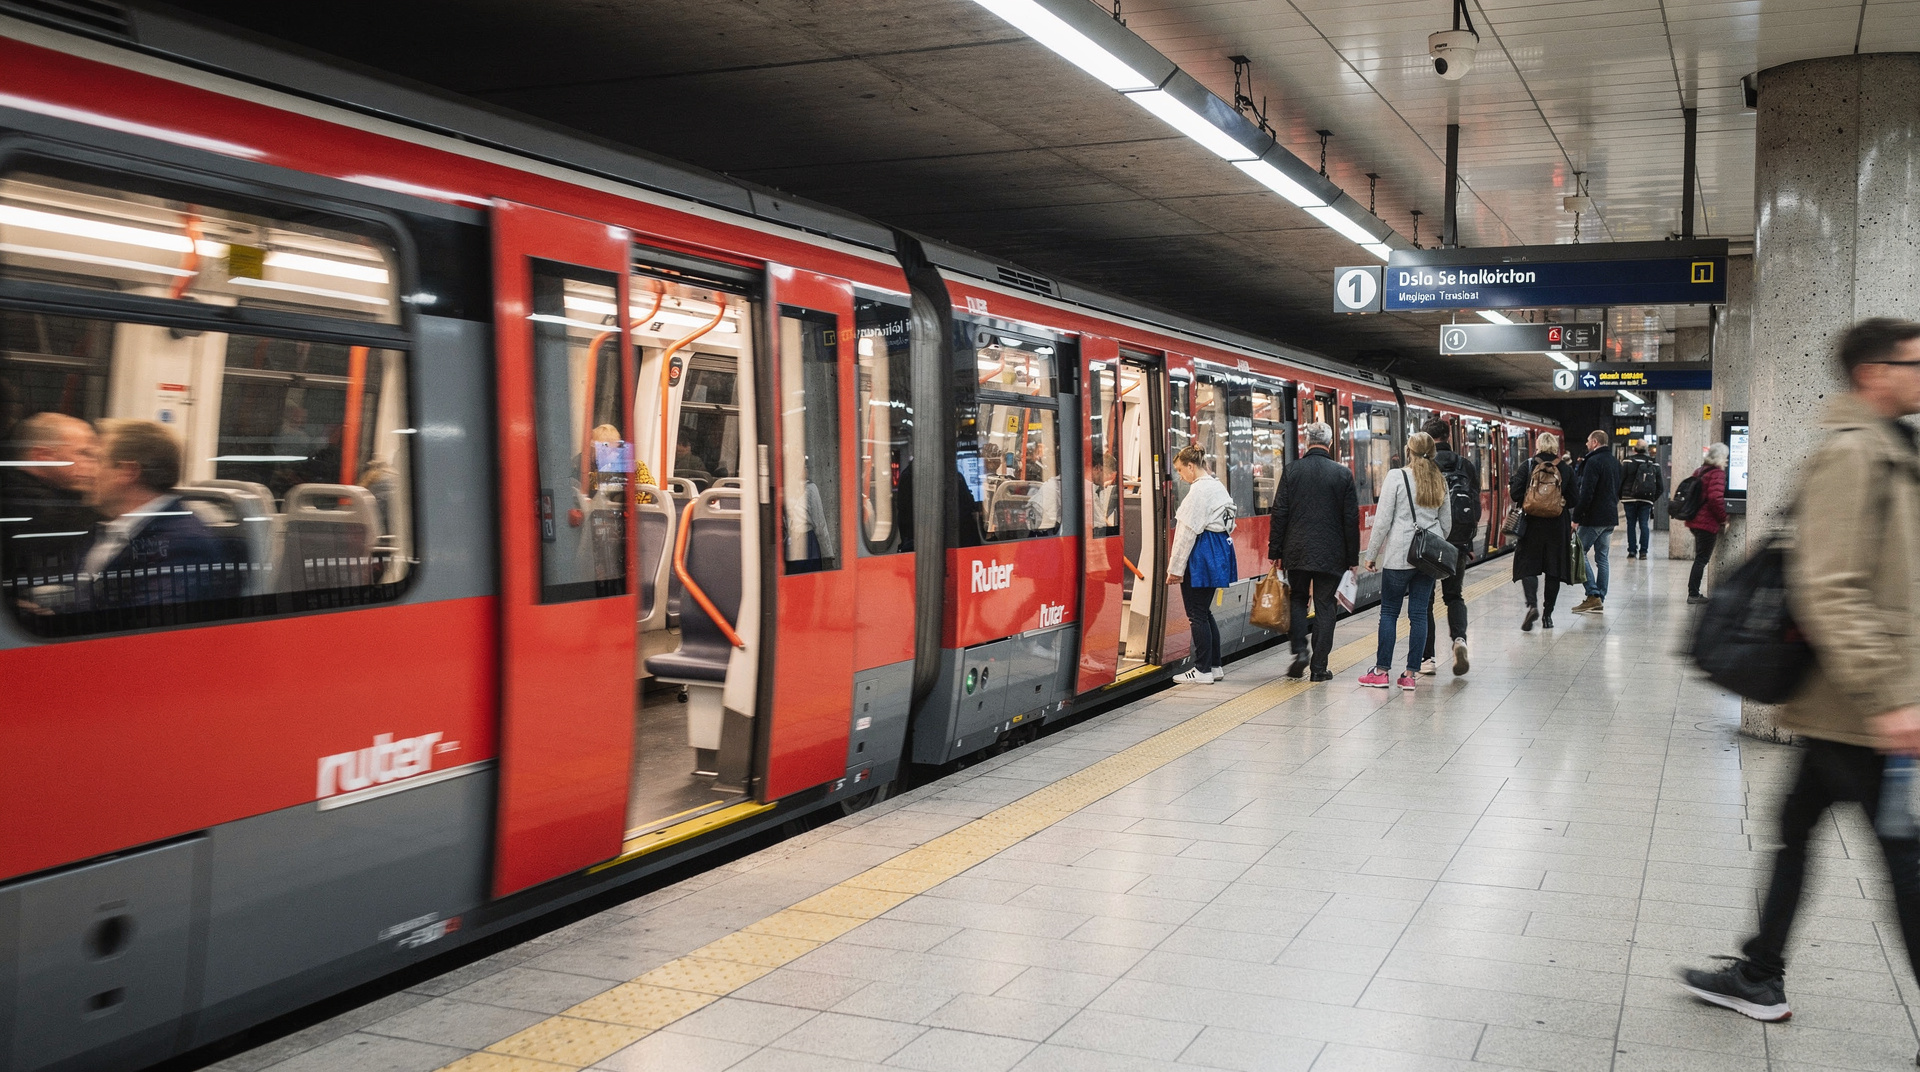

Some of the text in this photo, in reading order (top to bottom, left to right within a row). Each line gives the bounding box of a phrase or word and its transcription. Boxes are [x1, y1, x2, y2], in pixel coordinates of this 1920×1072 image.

[1348, 274, 1362, 303] 1
[1559, 373, 1567, 386] 1
[971, 559, 1014, 594] Ruter
[316, 730, 444, 800] ruter
